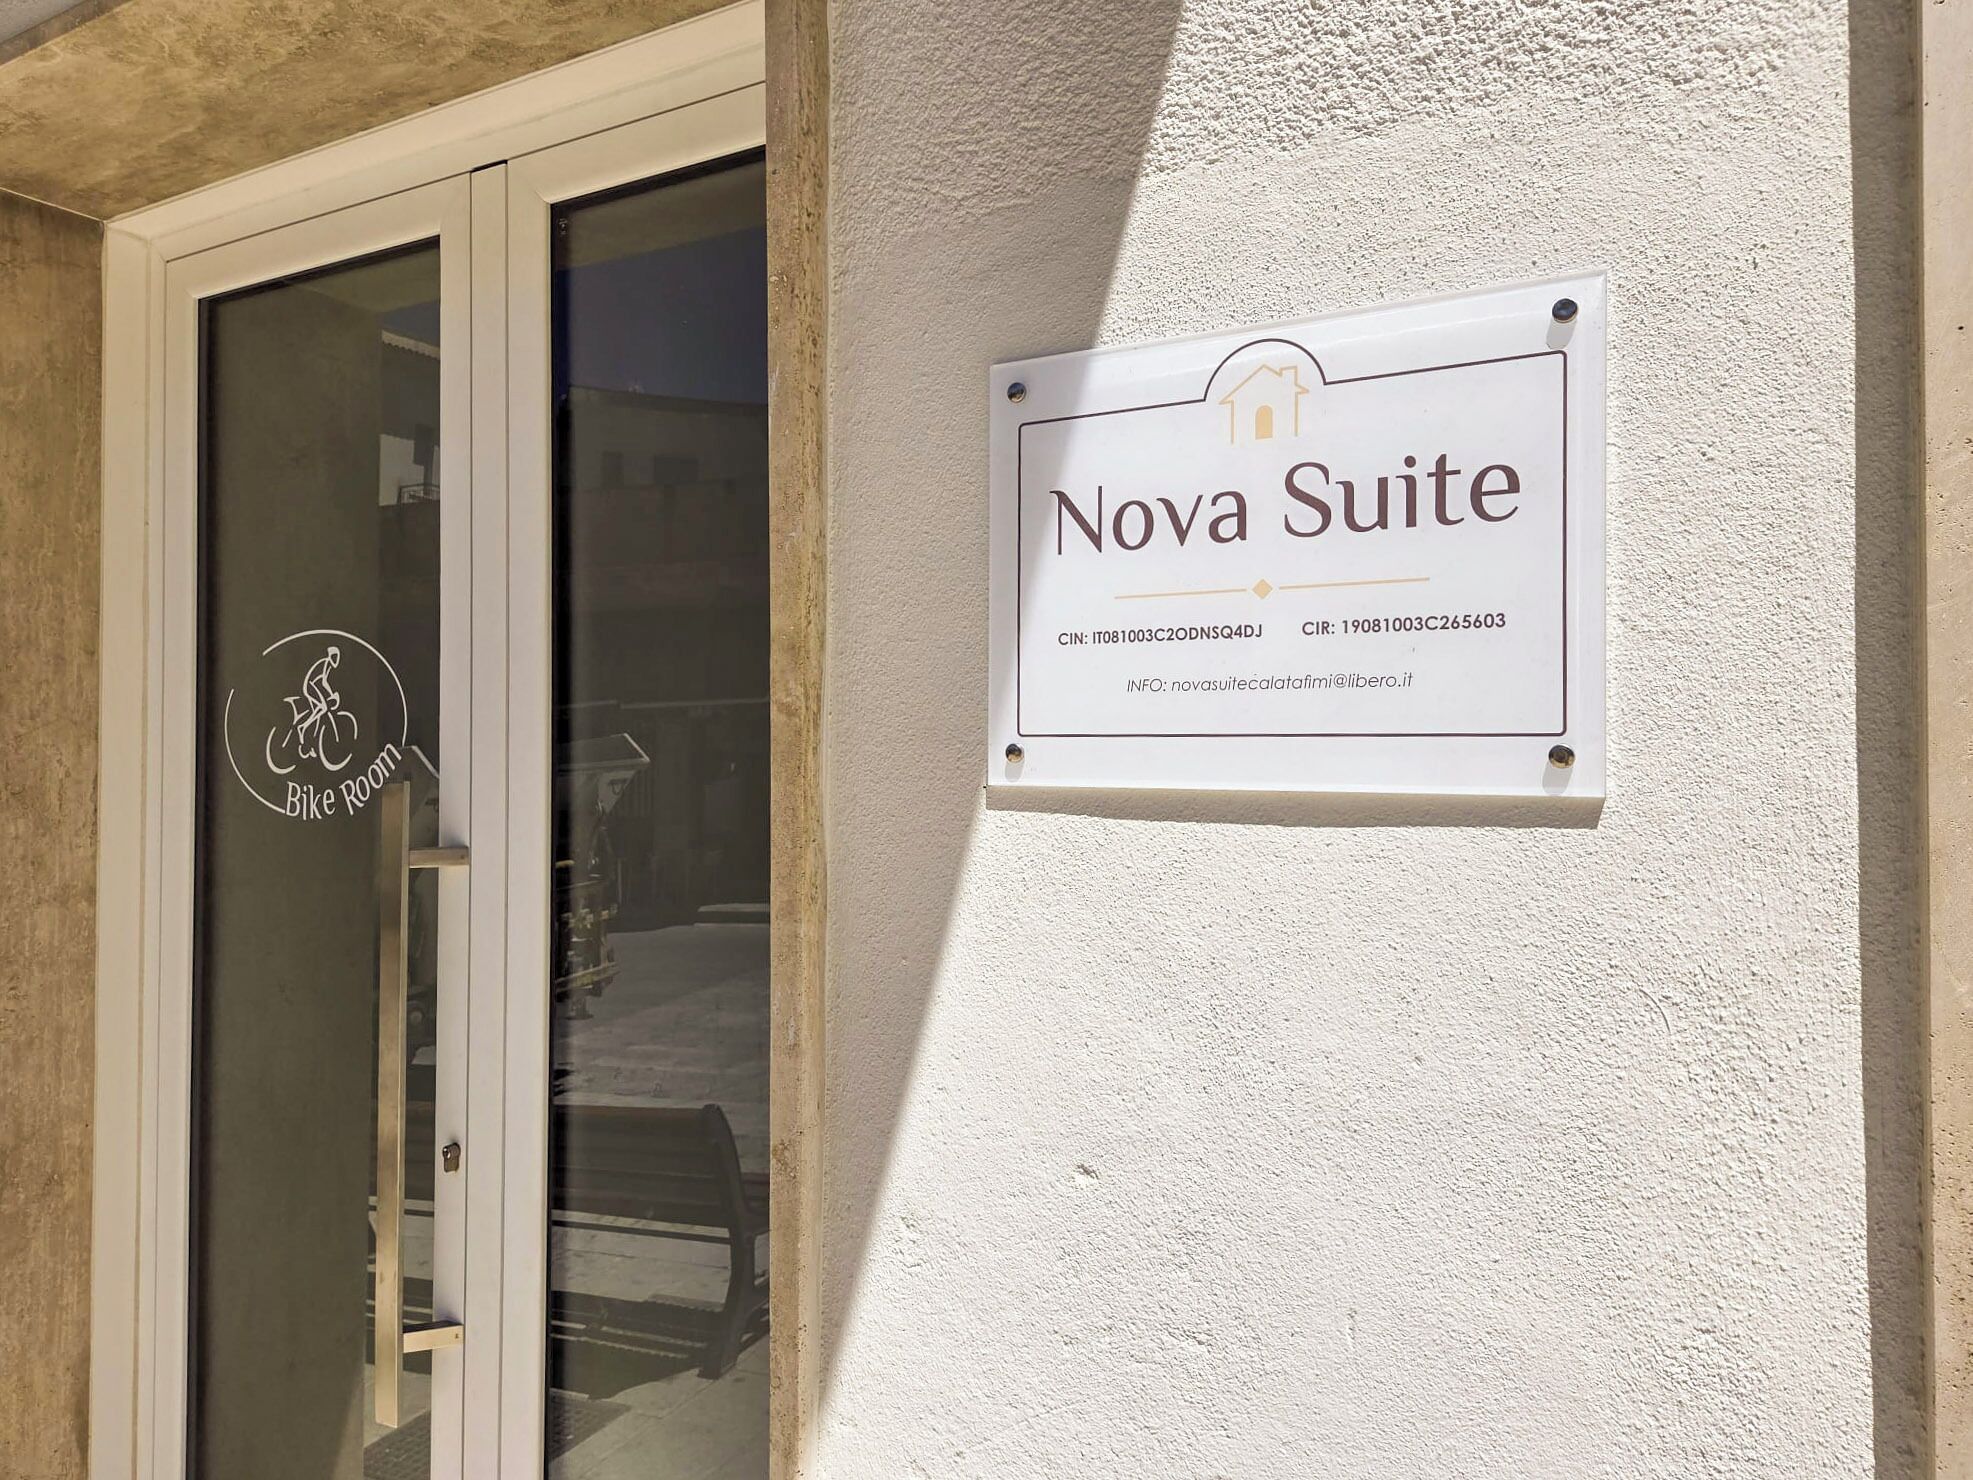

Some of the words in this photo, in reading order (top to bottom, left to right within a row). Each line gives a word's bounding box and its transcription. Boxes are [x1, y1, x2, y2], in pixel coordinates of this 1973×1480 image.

[1048, 485, 1248, 556] Nova
[1283, 453, 1521, 538] Suite
[1301, 620, 1336, 636] CIR:
[1341, 612, 1507, 635] 19081003C265603
[1057, 632, 1089, 646] CIN:
[1126, 678, 1167, 693] INFO:
[1171, 672, 1414, 692] novasuitecalatafimi@libero.it
[284, 781, 336, 821] Bike
[339, 743, 403, 816] Room
